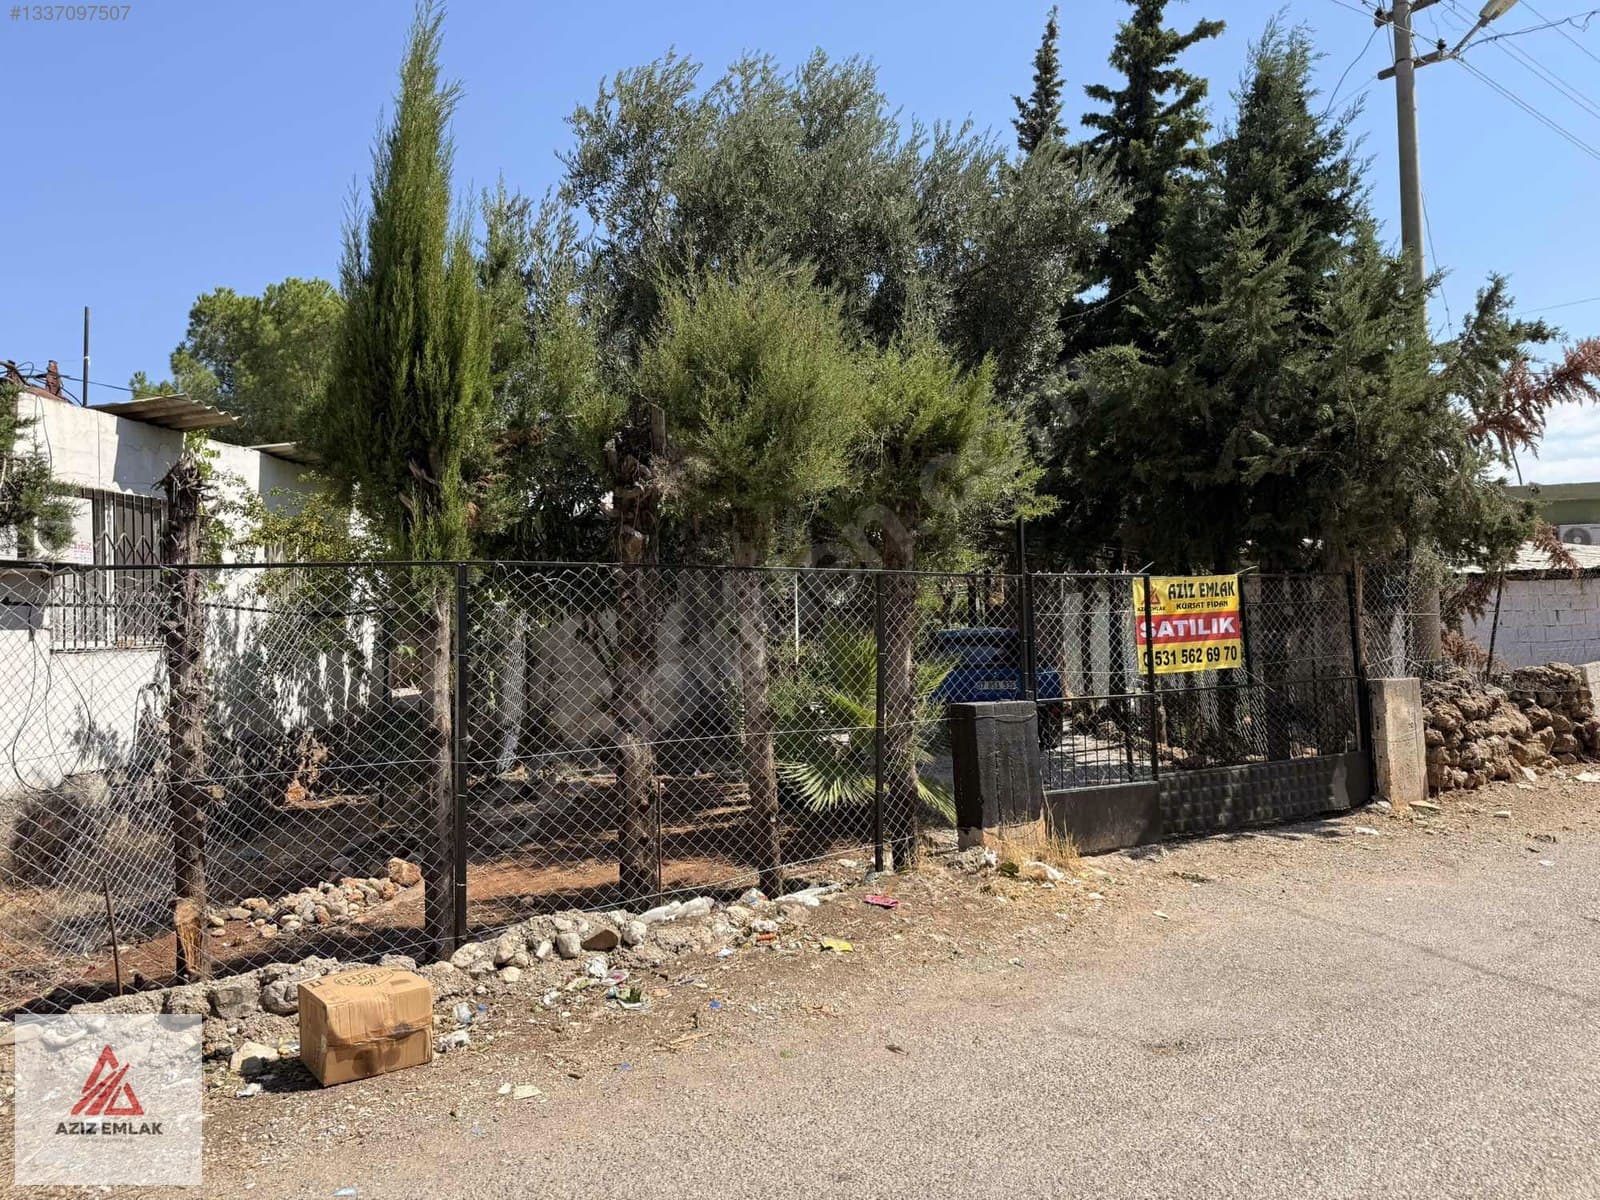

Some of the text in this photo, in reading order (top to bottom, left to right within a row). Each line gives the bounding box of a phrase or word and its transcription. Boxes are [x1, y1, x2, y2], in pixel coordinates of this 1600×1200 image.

[1168, 580, 1235, 600] AZİZ EMLAK
[1140, 617, 1235, 638] SATILIK
[1155, 650, 1176, 666] 531
[1181, 648, 1202, 664] 562
[1206, 647, 1220, 662] 69
[1224, 646, 1237, 660] 70
